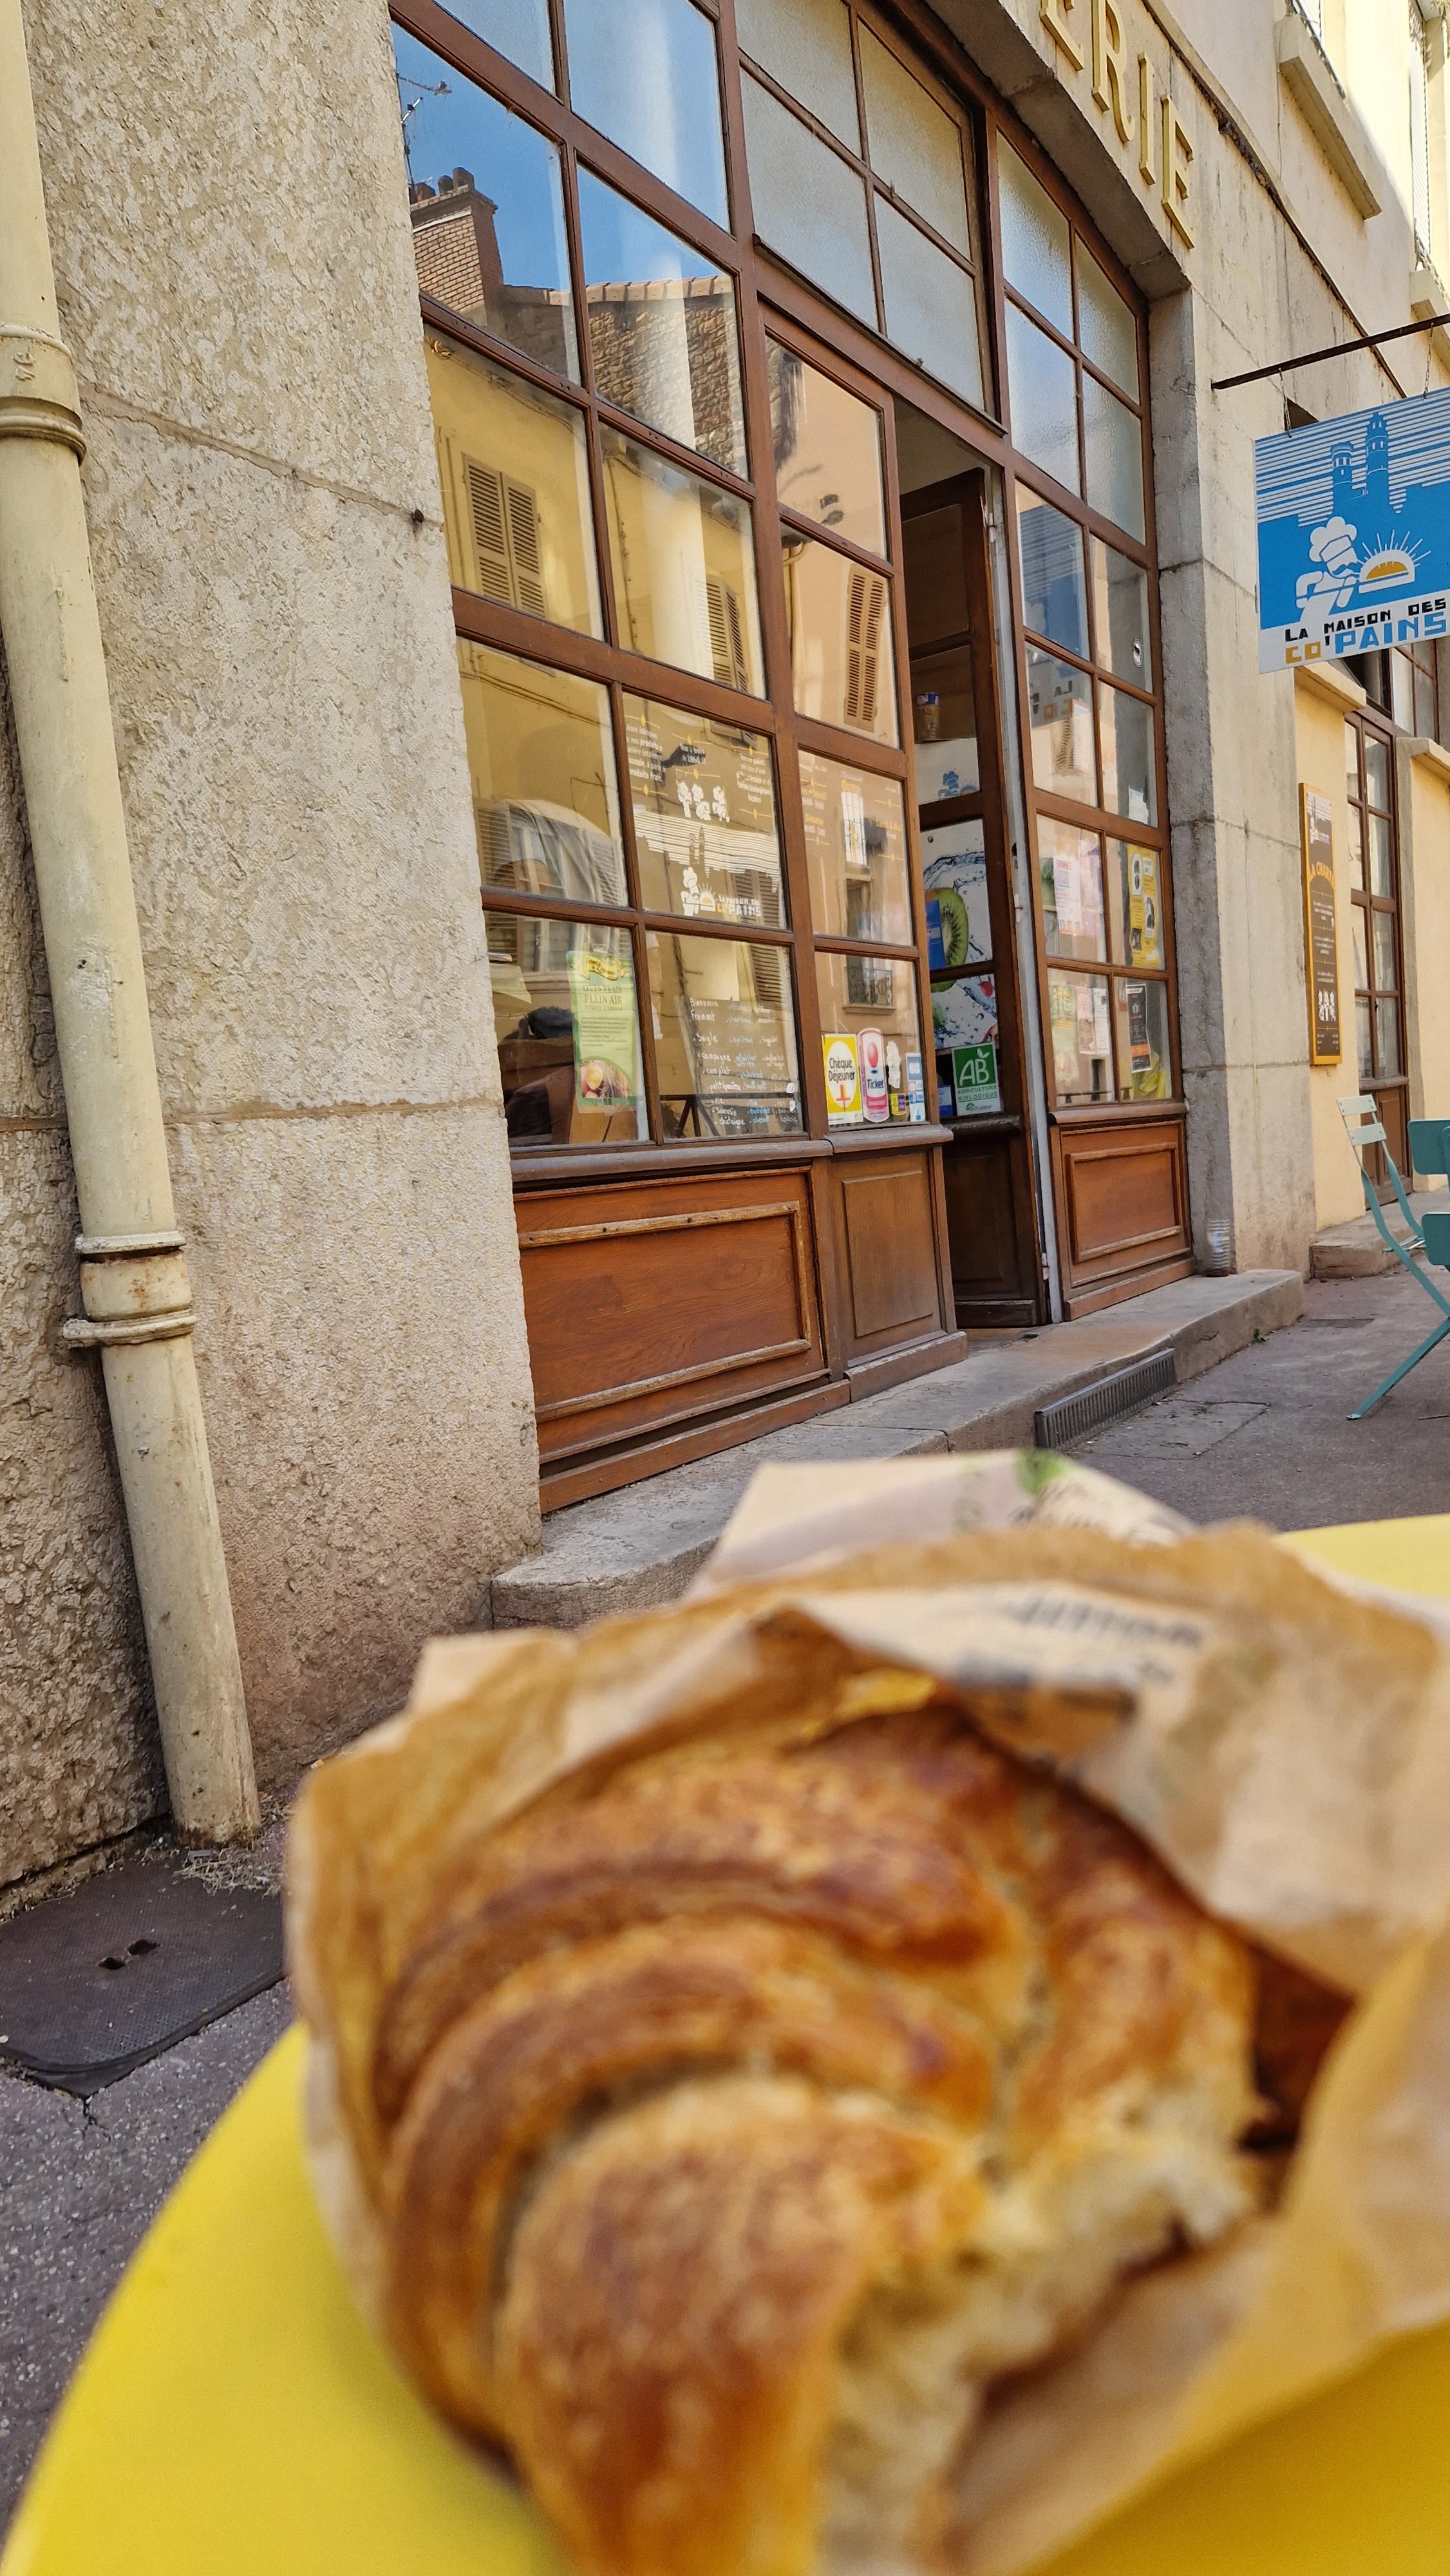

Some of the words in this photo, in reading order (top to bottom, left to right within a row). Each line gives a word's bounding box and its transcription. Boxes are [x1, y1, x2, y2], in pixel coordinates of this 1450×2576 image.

[1285, 629, 1308, 642] LA
[1324, 609, 1391, 633] MAISON
[1408, 598, 1446, 616] DES
[585, 994, 607, 1004] PLEIN
[609, 996, 623, 1005] AIR
[829, 1057, 852, 1070] Chèque
[828, 1070, 855, 1084] Déjeuner
[959, 1058, 990, 1086] AB
[867, 1079, 884, 1090] Ticket
[957, 1085, 997, 1095] AGRICULTURE
[958, 1092, 997, 1101] BIOLOGIQUE
